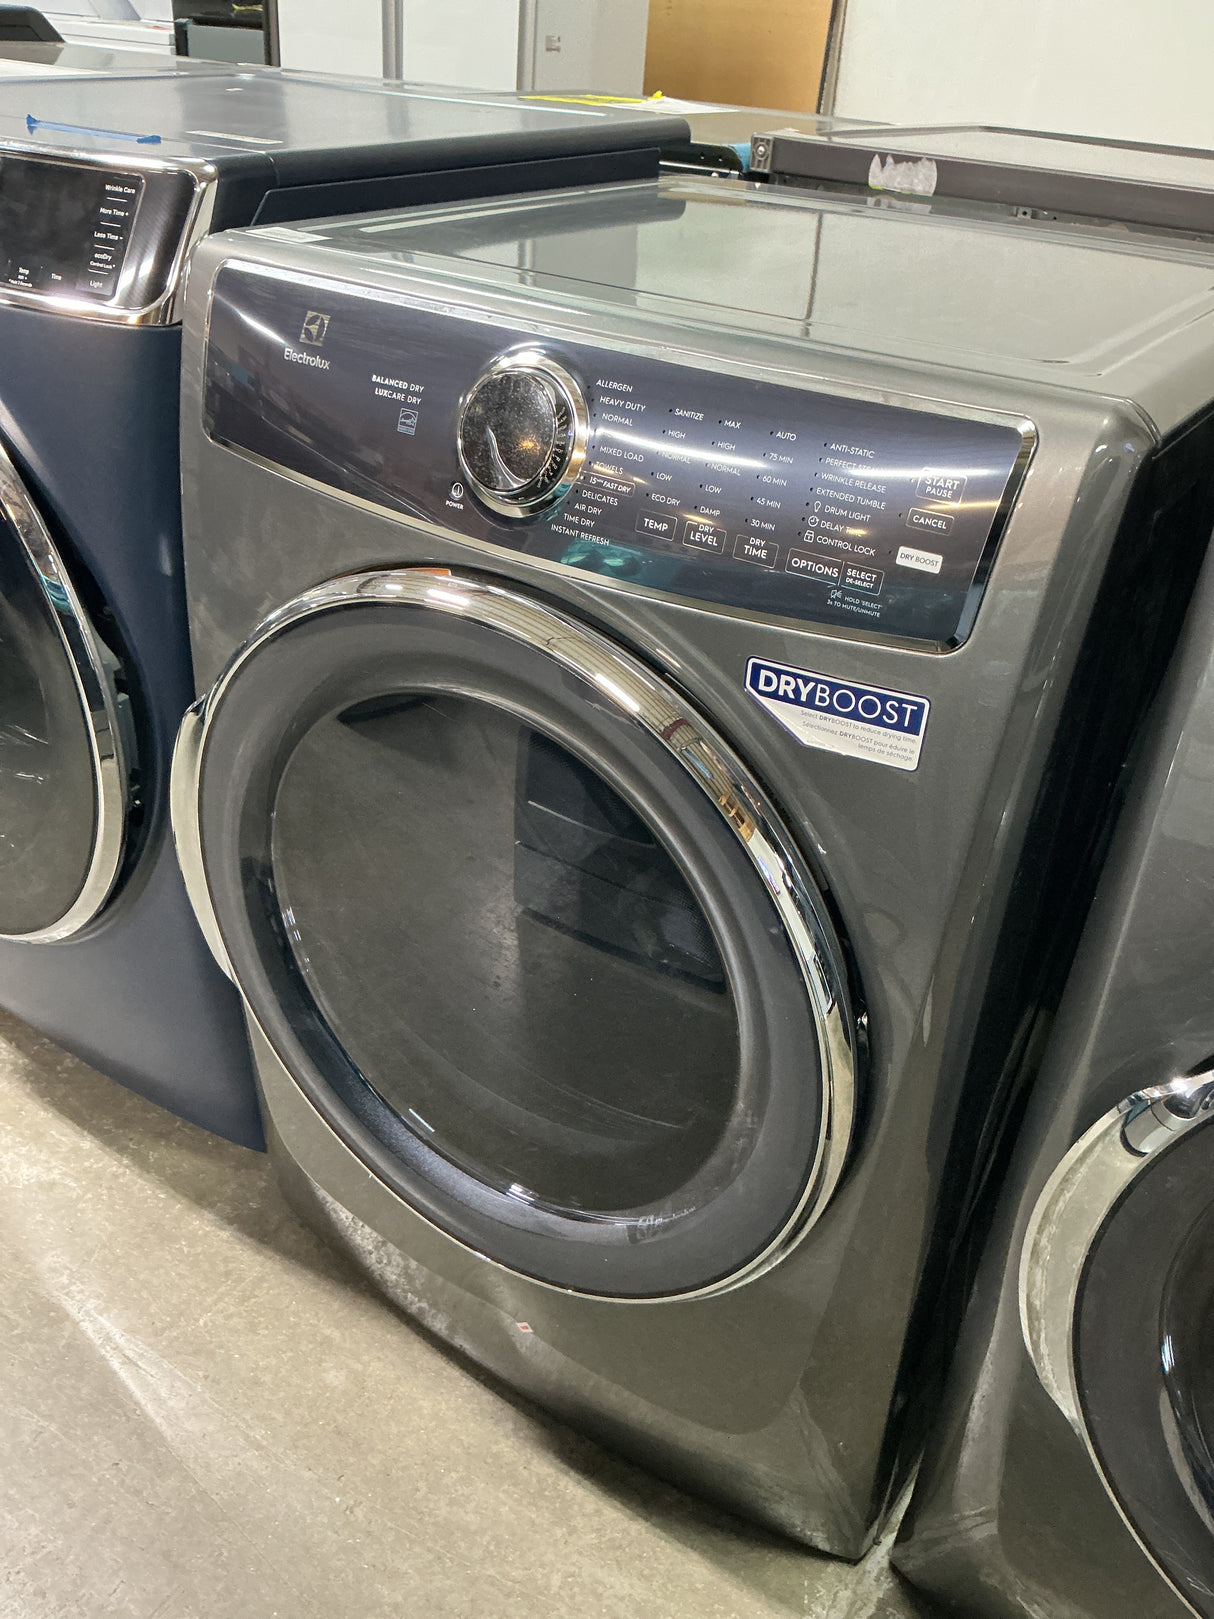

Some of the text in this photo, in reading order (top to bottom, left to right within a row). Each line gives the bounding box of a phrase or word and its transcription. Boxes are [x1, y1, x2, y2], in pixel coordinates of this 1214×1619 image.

[105, 184, 123, 193] Wrinkle
[100, 207, 112, 215] More
[113, 209, 124, 217] Time
[90, 280, 102, 288] Light
[284, 347, 330, 370] Electrolux
[371, 374, 424, 393] BALANCED DRY
[596, 379, 633, 392] ALLERGEN
[374, 387, 422, 405] LUXCARE DRY
[600, 396, 646, 412] HEAVY DUTY
[602, 413, 633, 426] NORMAL
[675, 408, 704, 421] SANITIZE
[724, 420, 742, 429] MAX
[668, 430, 686, 439] HIGH
[776, 432, 796, 441] AUTO
[718, 441, 736, 450] HIGH
[830, 444, 876, 458] ANTI-STATIC
[600, 446, 644, 462] MIXED LOAD
[662, 452, 691, 464] NORMAL
[770, 452, 794, 464] 75 MIN
[596, 461, 624, 474] TOWELS
[711, 463, 741, 476] NORMAL
[826, 458, 856, 470] PERFECT
[656, 472, 672, 481] LOW
[762, 475, 787, 487] 60 MIN
[821, 472, 887, 494] WRINKLE RELEASE
[925, 476, 960, 490] START
[603, 481, 618, 490] FAST
[618, 485, 631, 493] DRY
[705, 485, 721, 494] LOW
[926, 486, 953, 499] PAUSE
[582, 490, 618, 506] DELICATES
[652, 493, 681, 506] ECO DRY
[756, 497, 781, 509] 45 MIN
[816, 487, 886, 510] EXTENDED TUMBLE
[445, 500, 463, 510] POWER
[574, 502, 602, 516] AIR DRY
[700, 506, 720, 516] DAMP
[824, 505, 871, 522] DRUM LIGHT
[564, 513, 595, 528] TIME DRY
[644, 518, 668, 532] TEMP
[750, 519, 776, 531] 30 MIN
[820, 521, 844, 532] DELAY
[912, 515, 947, 530] CANCEL
[551, 524, 610, 546] INSTANT REFRESH
[698, 524, 714, 534] DRY
[690, 531, 718, 546] LEVEL
[749, 537, 766, 547] DRY
[744, 545, 768, 559] TIME
[816, 535, 876, 557] CONTROL LOCK
[900, 552, 939, 567] DRY BOOST
[791, 558, 839, 578] OPTIONS
[847, 568, 877, 582] SELECT
[846, 578, 874, 589] DE-SELECT
[844, 596, 860, 605] HOLD
[842, 603, 881, 618] MUTE/UNMUTE
[758, 669, 918, 728] DRYBOOST
[801, 710, 818, 720] Select
[820, 714, 852, 728] DRYBOOST
[860, 725, 880, 735] reduce
[882, 731, 902, 742] drying
[840, 730, 873, 744] DRYBOOST
[874, 740, 888, 749] pour
[858, 743, 876, 754] temps
